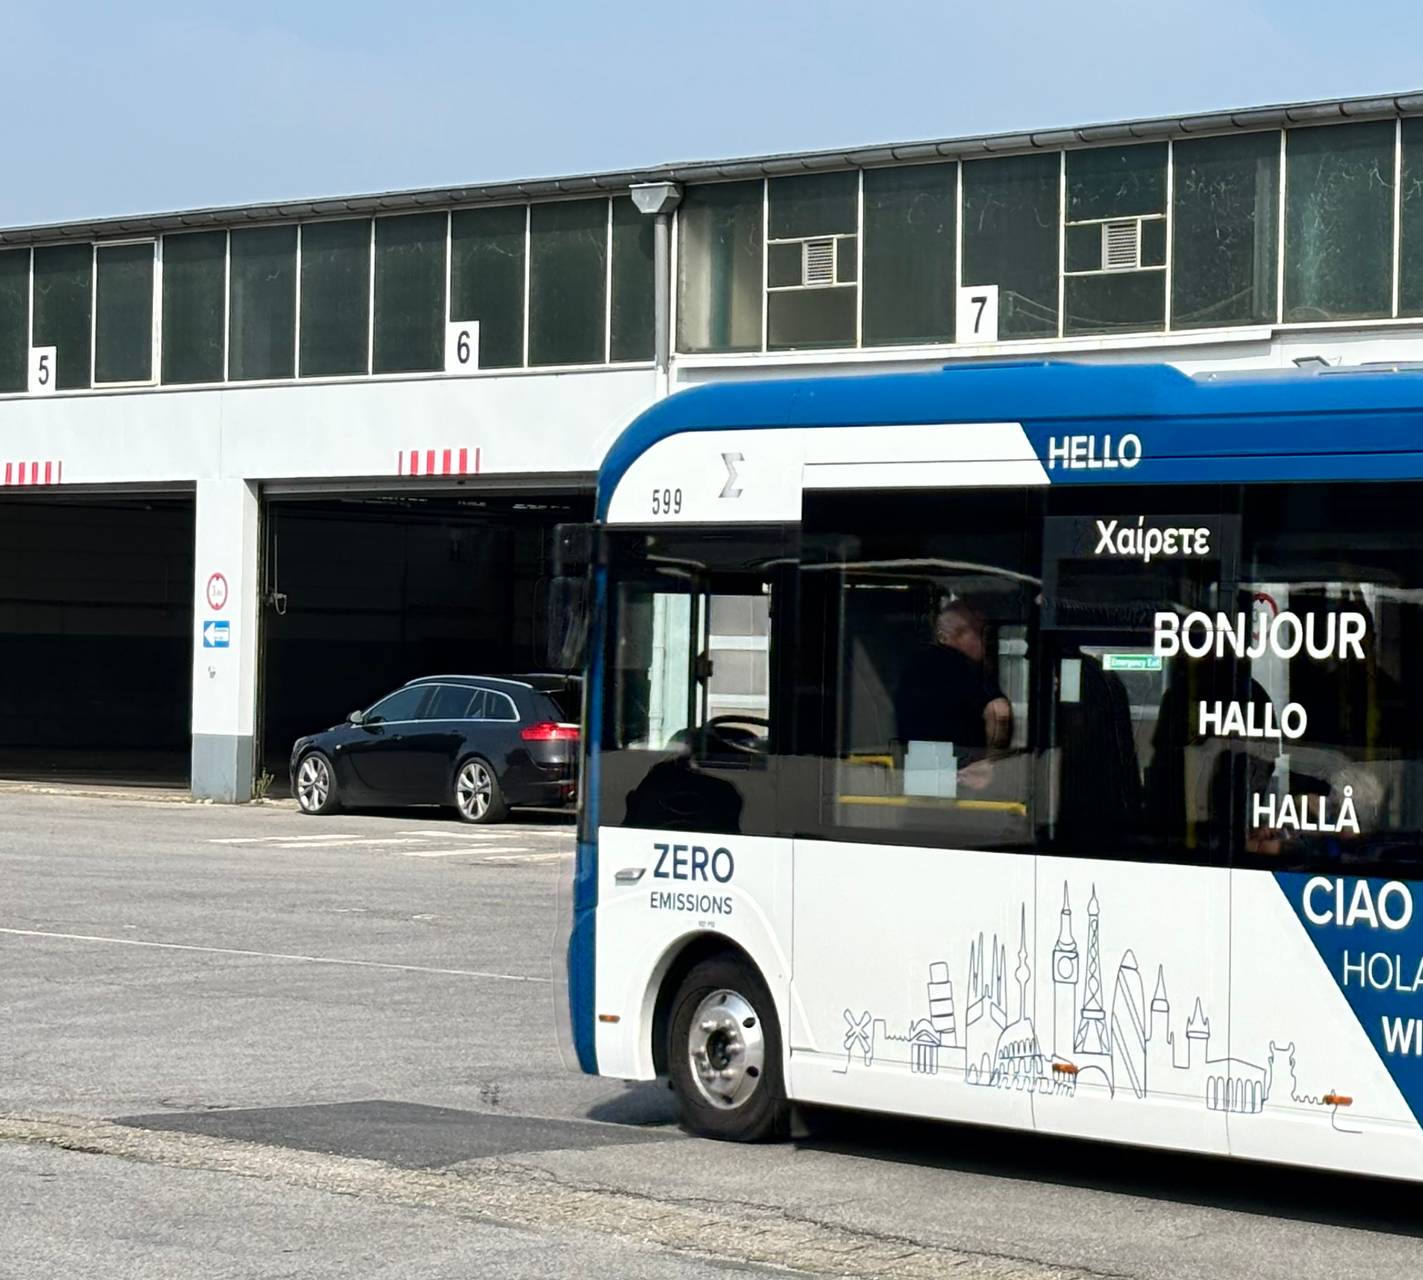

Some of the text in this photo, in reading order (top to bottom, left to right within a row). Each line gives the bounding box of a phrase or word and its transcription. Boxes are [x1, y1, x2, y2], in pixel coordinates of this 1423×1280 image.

[970, 295, 988, 334] 7
[457, 330, 471, 364] 6
[38, 354, 50, 386] 5
[1048, 433, 1142, 470] HELLO
[652, 488, 682, 515] 599
[1094, 515, 1211, 563] Χαίρετε
[1153, 610, 1368, 661] BONJOUR
[1199, 700, 1308, 740] HALLO
[1252, 785, 1361, 834] HALLÅ
[652, 843, 735, 884] ZERO
[649, 891, 733, 915] EMISSIONS
[1302, 876, 1414, 931] CIAO
